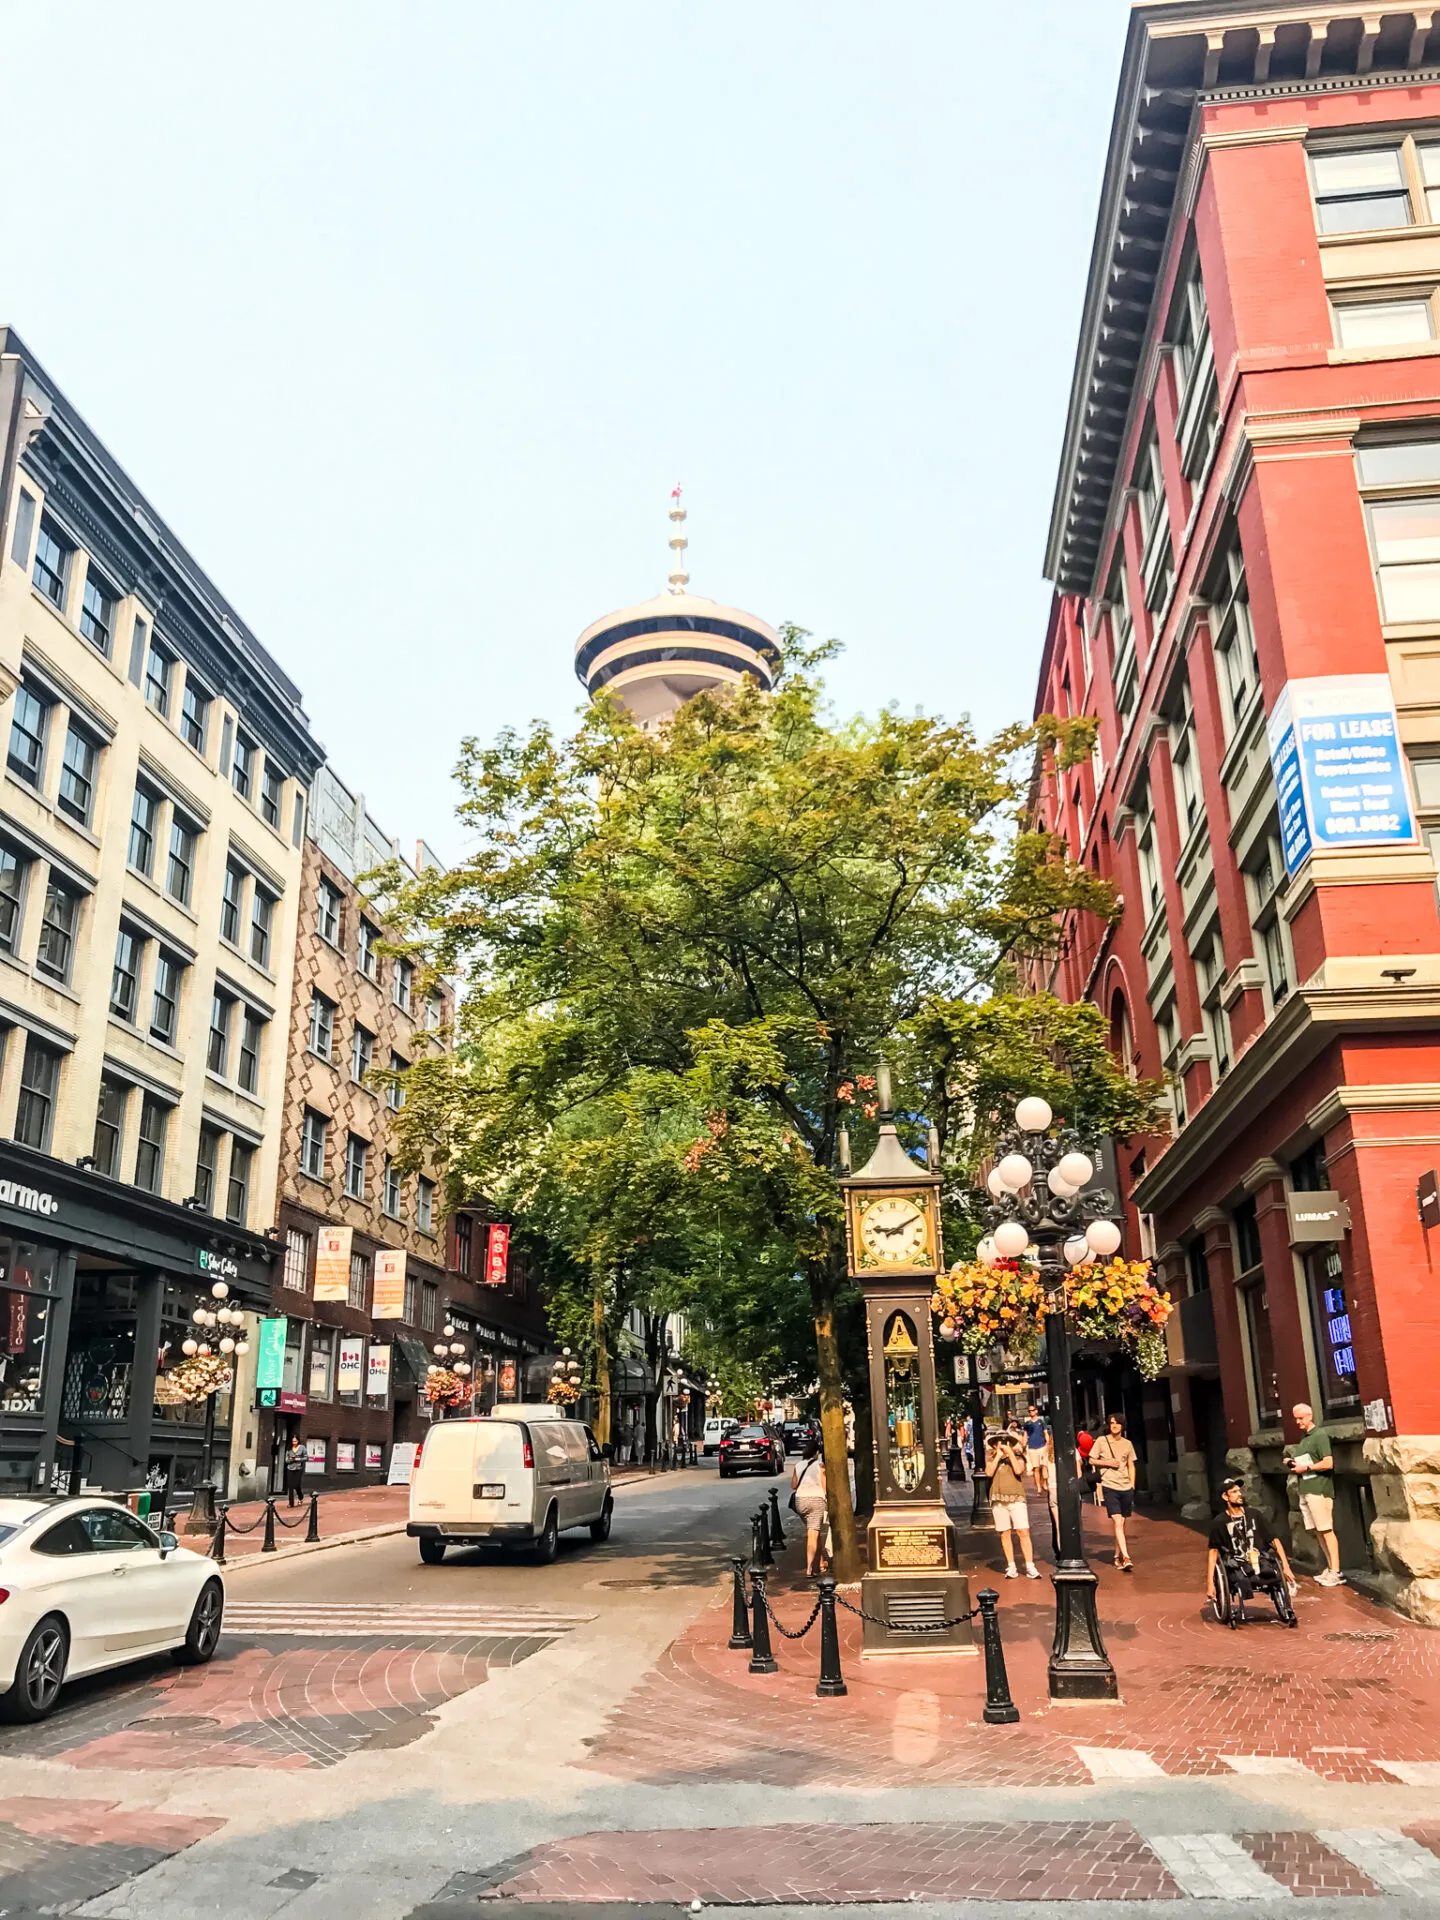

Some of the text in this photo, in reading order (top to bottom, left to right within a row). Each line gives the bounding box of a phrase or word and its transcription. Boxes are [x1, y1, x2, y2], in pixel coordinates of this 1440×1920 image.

[1302, 719, 1394, 742] FOR LEASE
[1295, 1212, 1331, 1222] LUMAS
[340, 1362, 360, 1370] OHC
